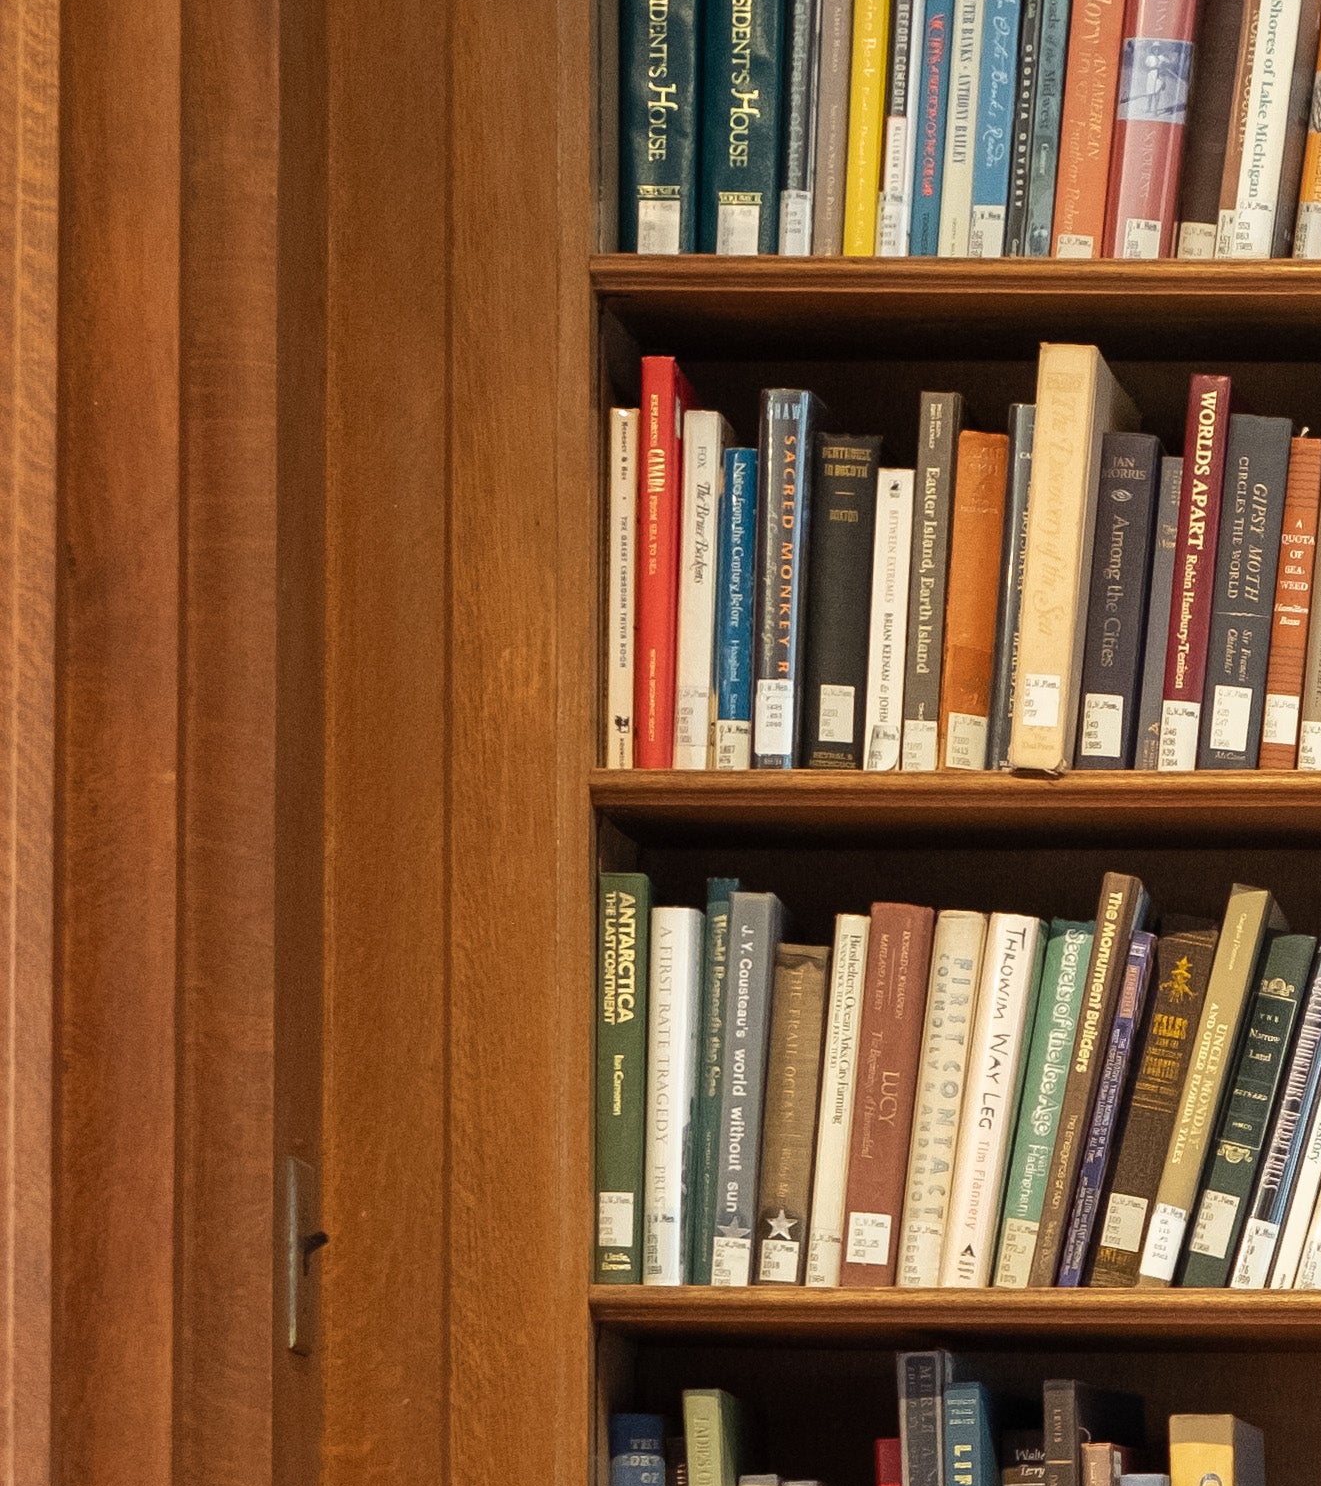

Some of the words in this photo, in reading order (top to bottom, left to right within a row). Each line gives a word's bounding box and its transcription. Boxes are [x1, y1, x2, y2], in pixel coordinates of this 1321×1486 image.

[1263, 0, 1283, 55] Shores
[1262, 59, 1276, 76] of
[1257, 81, 1274, 117] Lake
[1248, 123, 1269, 198] Michigan
[1194, 391, 1217, 475] WORLDS
[923, 467, 940, 518] Easter
[1187, 480, 1209, 550] APART
[918, 521, 937, 573] Island,
[1103, 514, 1129, 581] Among
[918, 576, 935, 621] Earth
[1106, 585, 1126, 612] the
[916, 624, 933, 673] Island
[1101, 618, 1123, 667] Cities
[616, 891, 636, 1023] ANTARCTICA
[738, 941, 751, 955] Y.
[740, 925, 753, 939] J.
[735, 959, 752, 1037] Cousteau's
[732, 1049, 748, 1095] world
[727, 1106, 745, 1170] without
[726, 1182, 739, 1212] sun
